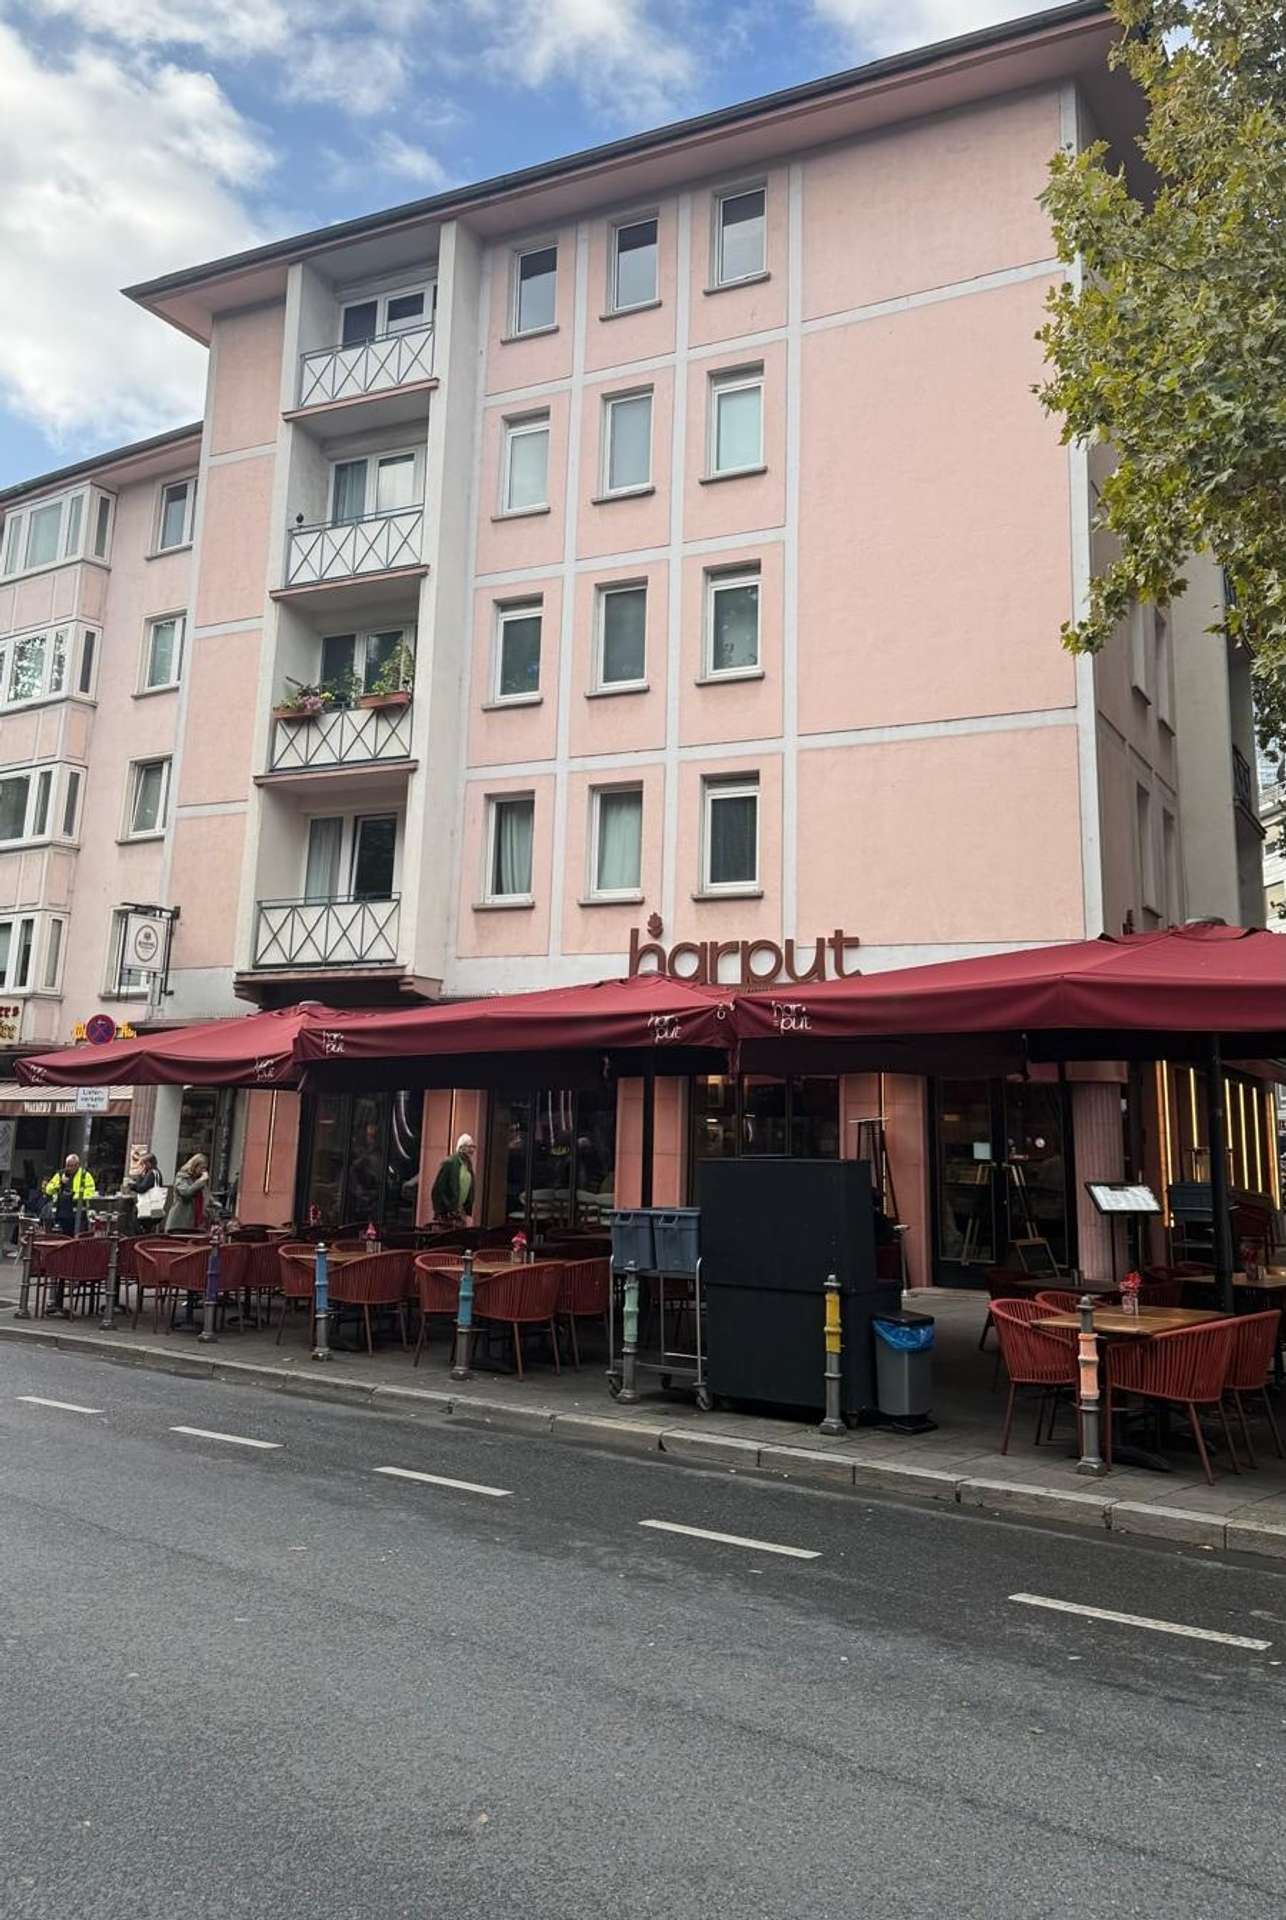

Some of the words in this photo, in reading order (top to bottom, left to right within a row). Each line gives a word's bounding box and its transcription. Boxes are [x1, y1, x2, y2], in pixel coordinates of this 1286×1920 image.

[629, 925, 861, 984] harput
[779, 1016, 812, 1034] put
[654, 1026, 682, 1044] put
